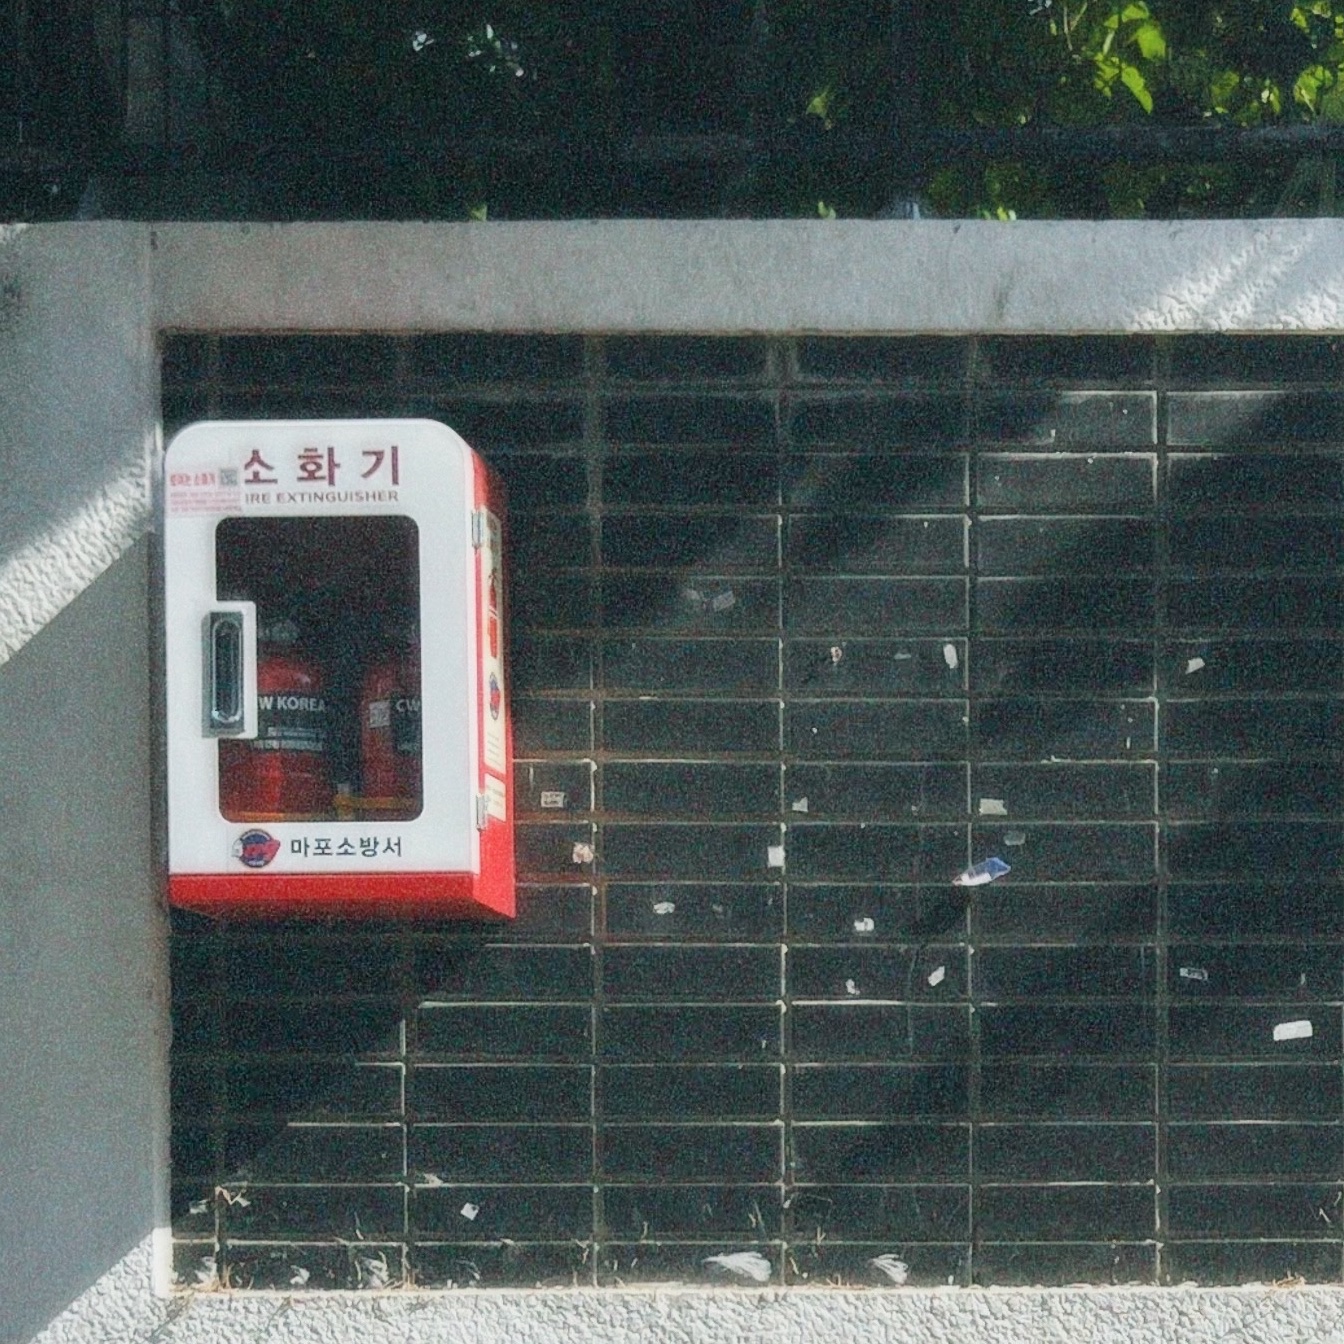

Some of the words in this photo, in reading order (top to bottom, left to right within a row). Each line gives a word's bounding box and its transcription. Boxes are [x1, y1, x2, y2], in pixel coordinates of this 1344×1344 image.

[244, 445, 399, 487] 소화기
[245, 492, 271, 505] IRE
[276, 489, 399, 505] EXTINGUISHER
[258, 695, 273, 710] W
[277, 695, 325, 712] KOREA
[291, 836, 402, 858] 마포소방서
